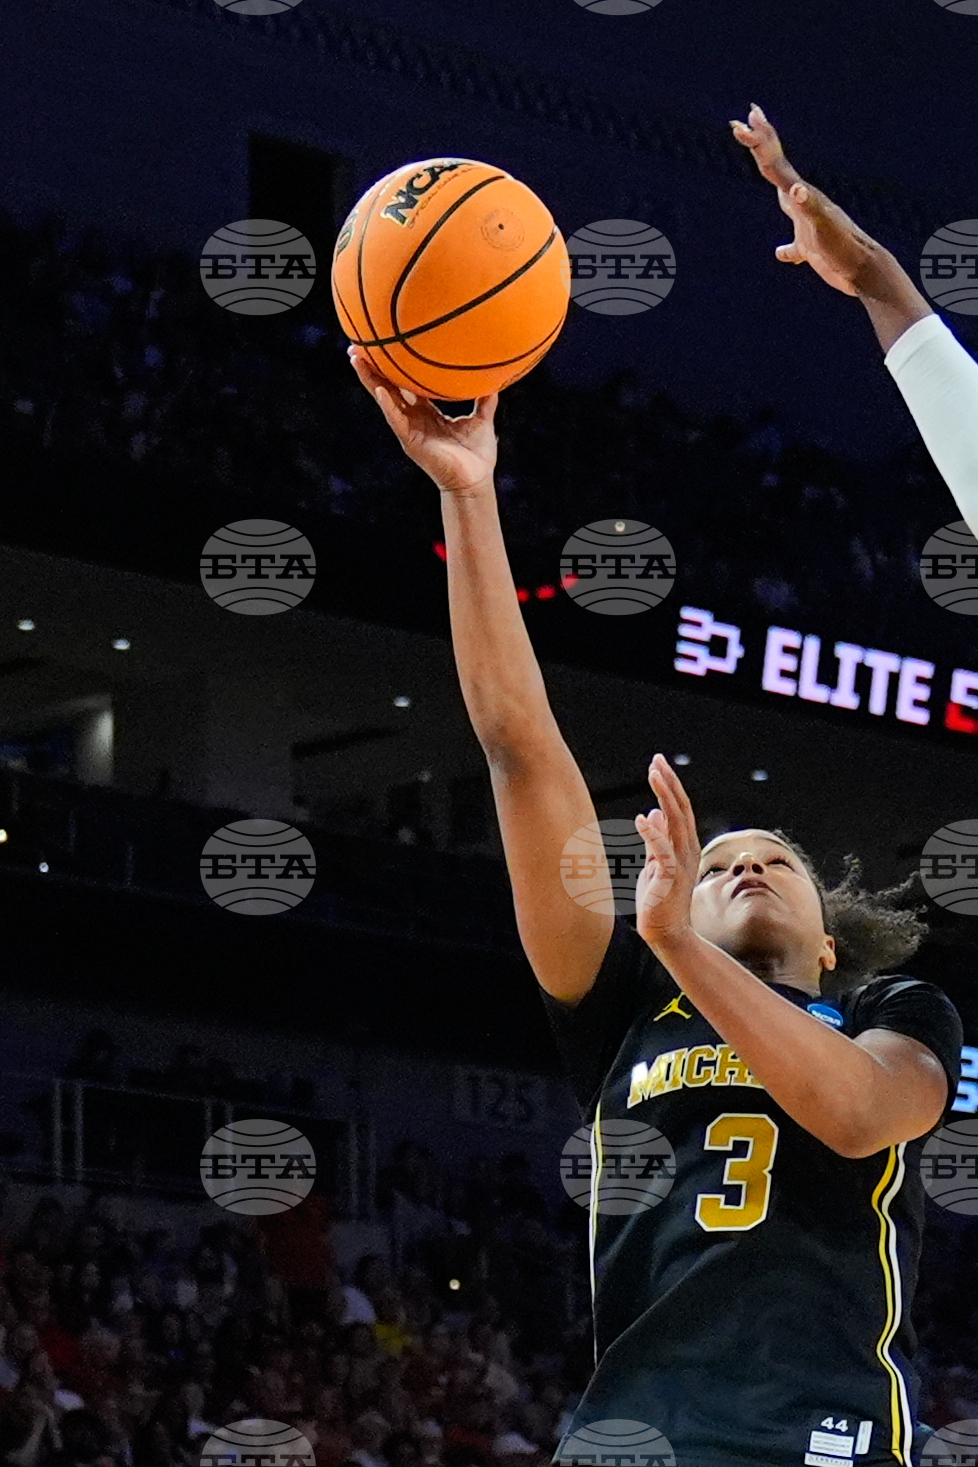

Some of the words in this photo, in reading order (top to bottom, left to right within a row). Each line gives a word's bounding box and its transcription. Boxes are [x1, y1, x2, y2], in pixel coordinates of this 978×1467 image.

[381, 162, 474, 227] NCAA
[762, 626, 935, 726] ELITE
[627, 1044, 765, 1109] MICH
[695, 1112, 780, 1232] 3
[820, 1416, 849, 1433] 44
